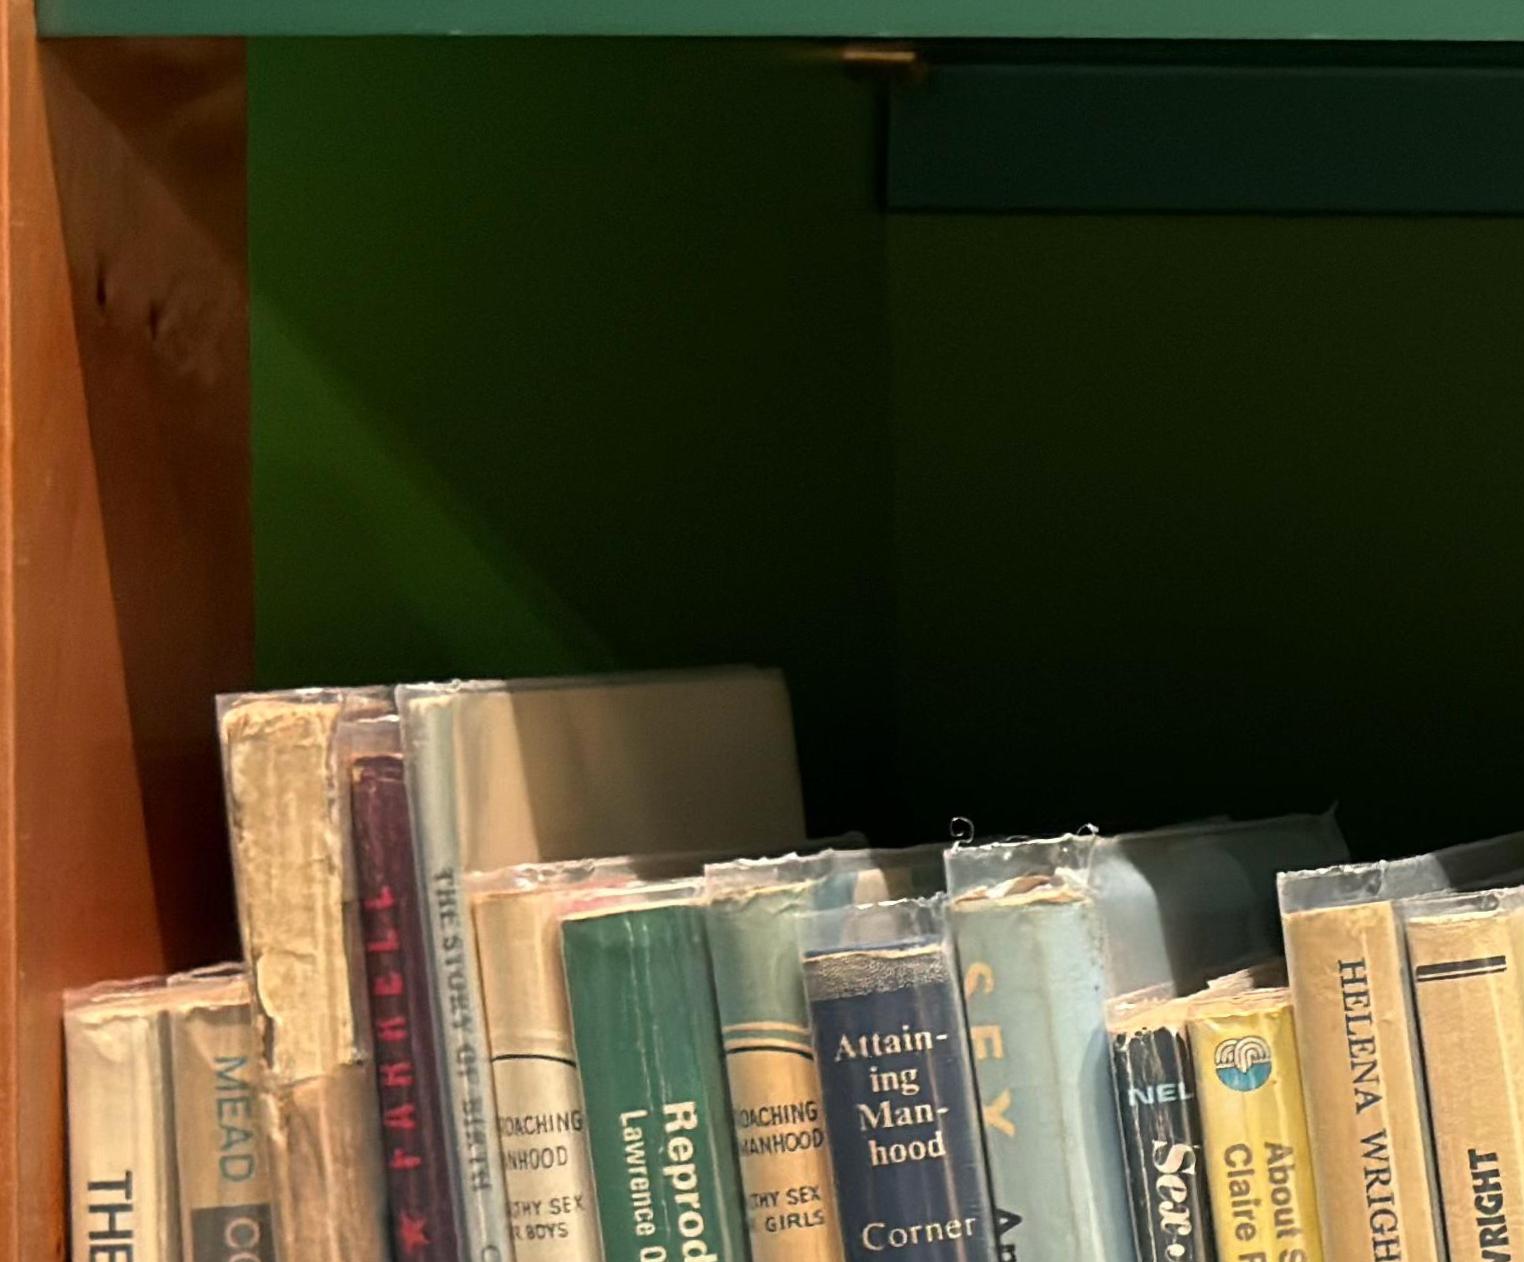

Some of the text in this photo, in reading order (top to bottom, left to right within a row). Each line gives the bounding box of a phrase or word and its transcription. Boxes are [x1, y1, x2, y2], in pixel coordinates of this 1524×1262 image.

[835, 1026, 948, 1061] Attain-
[869, 1066, 919, 1094] ing
[214, 1056, 255, 1183] MEAD
[857, 1103, 949, 1131] Man-
[869, 1134, 946, 1166] hood
[619, 1109, 653, 1239] Lawrence
[1224, 1146, 1257, 1246] Claire
[1263, 1142, 1299, 1244] About
[862, 1216, 976, 1250] Corner
